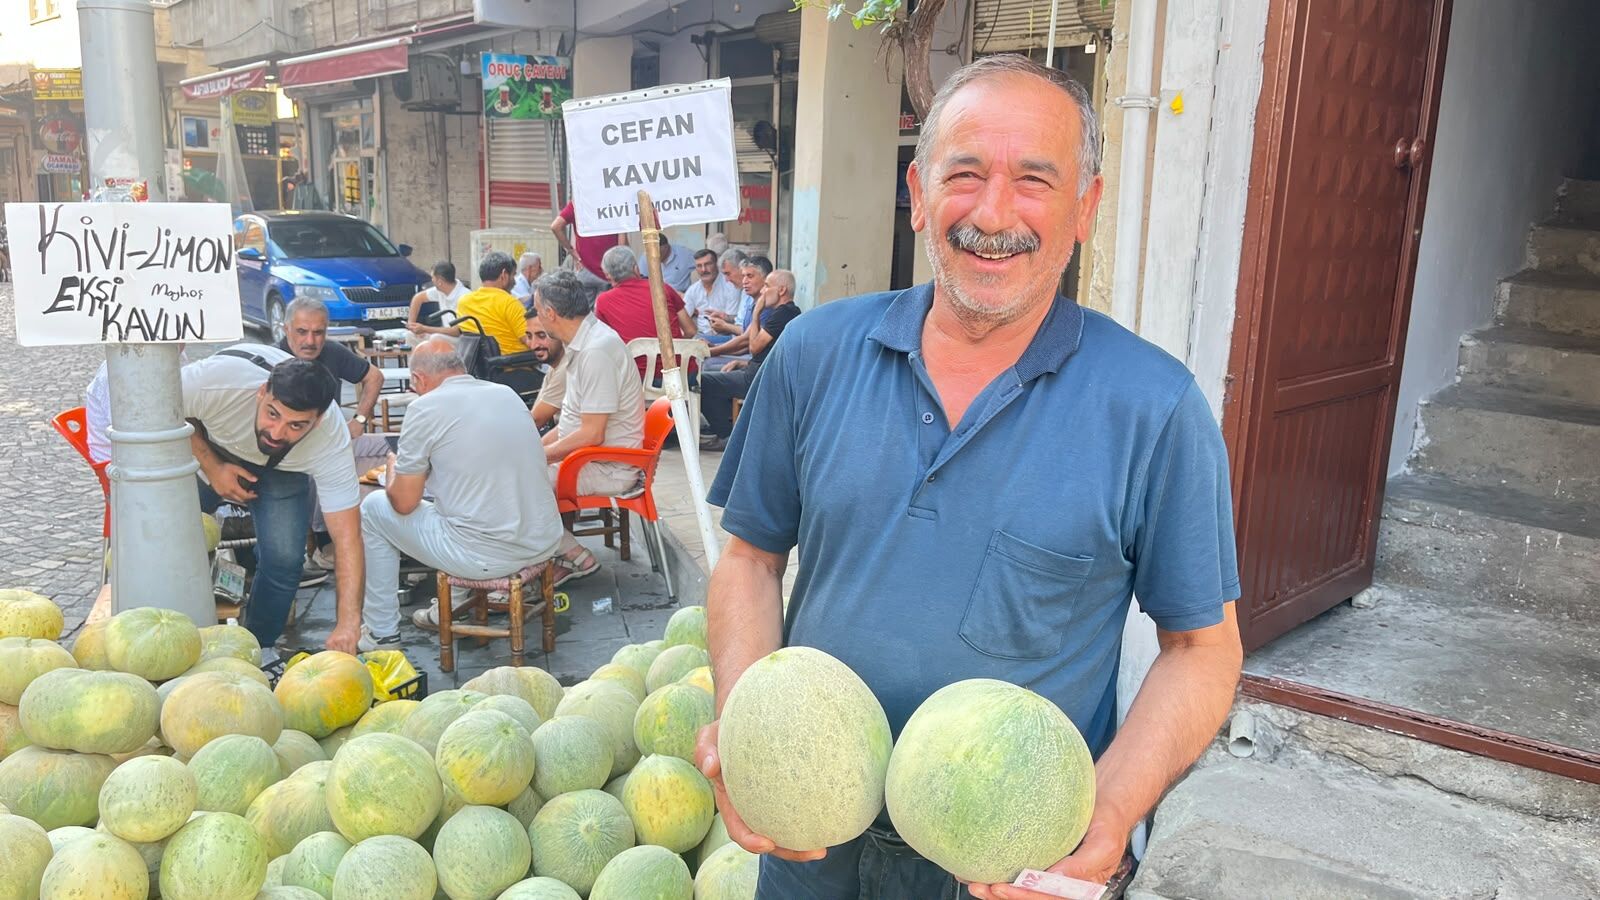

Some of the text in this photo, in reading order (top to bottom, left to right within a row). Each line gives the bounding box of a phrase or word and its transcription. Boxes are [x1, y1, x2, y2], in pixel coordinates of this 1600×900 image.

[488, 63, 567, 81] ORUÇ ÇAYEVİ
[601, 112, 695, 146] CEFAN
[602, 155, 702, 189] KAVUN
[597, 194, 715, 220] KİVİ LMONATA
[101, 304, 206, 342] KAVUN
